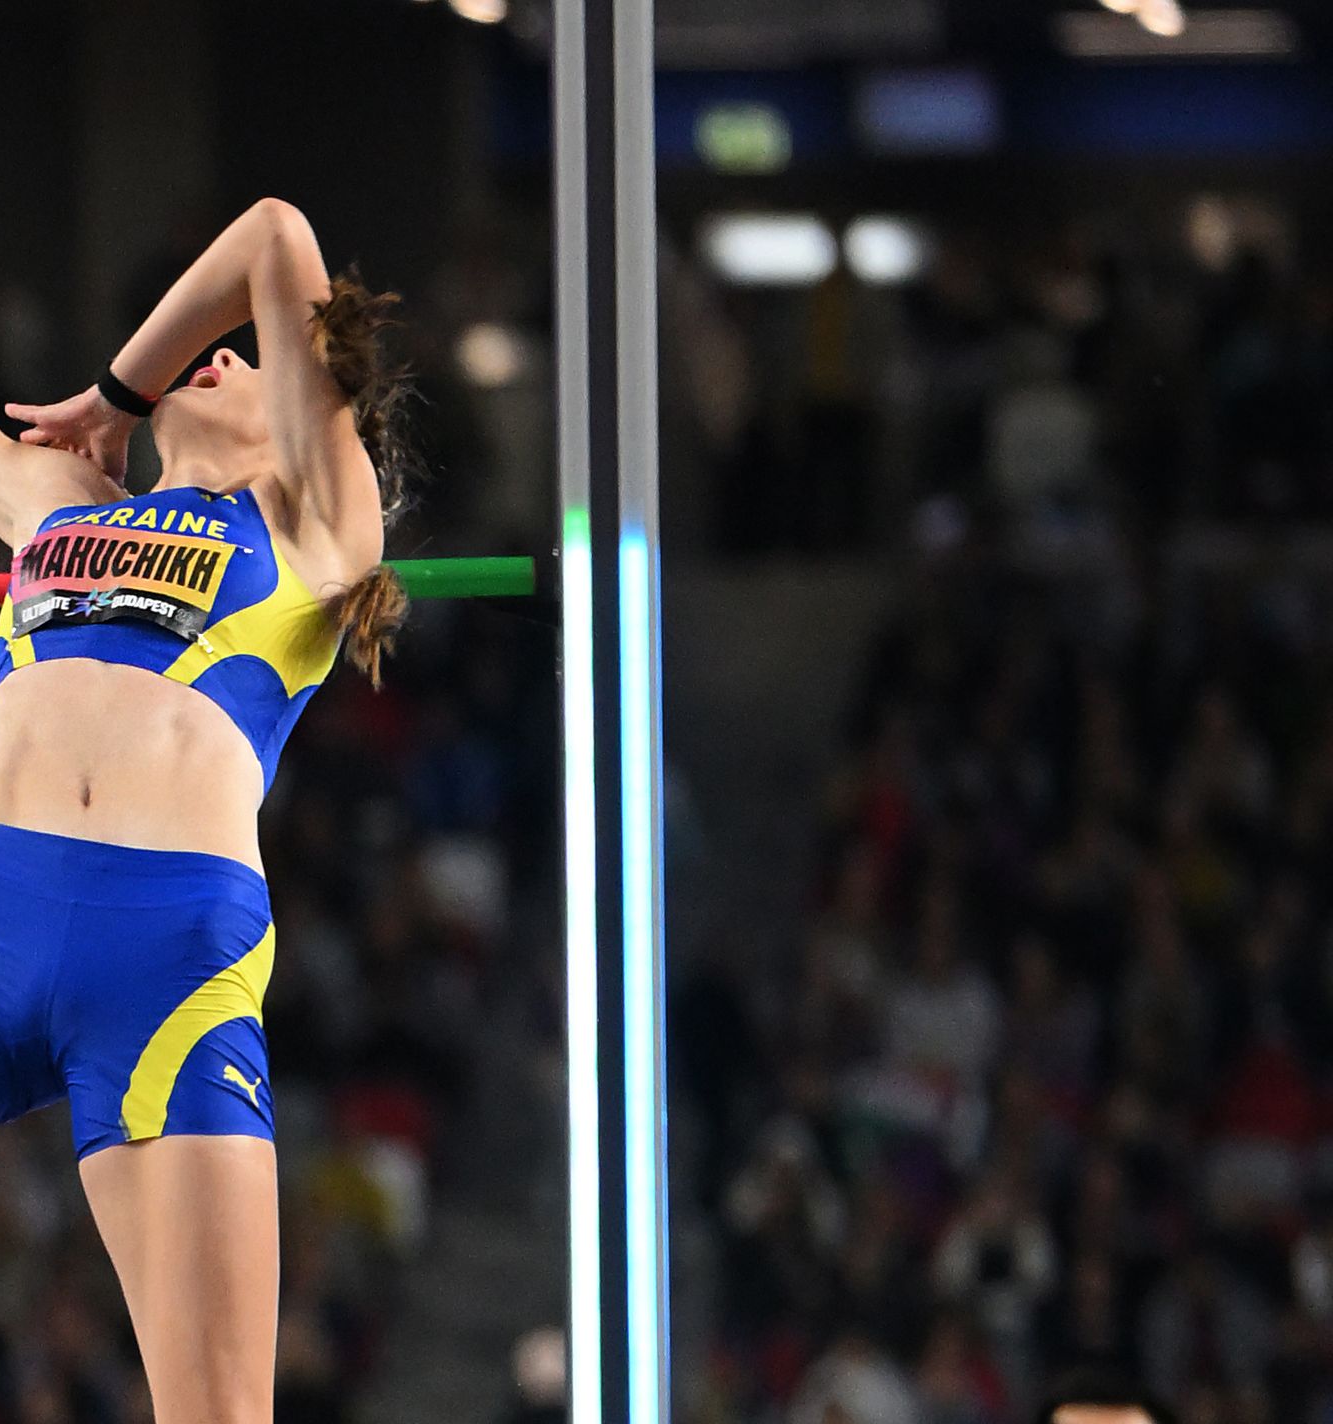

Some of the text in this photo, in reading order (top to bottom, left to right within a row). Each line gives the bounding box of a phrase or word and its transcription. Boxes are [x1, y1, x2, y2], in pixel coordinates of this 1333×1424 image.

[50, 508, 229, 539] UKRAINE
[19, 536, 221, 594] MAHUCHIKH
[111, 595, 178, 618] BUDAPEST
